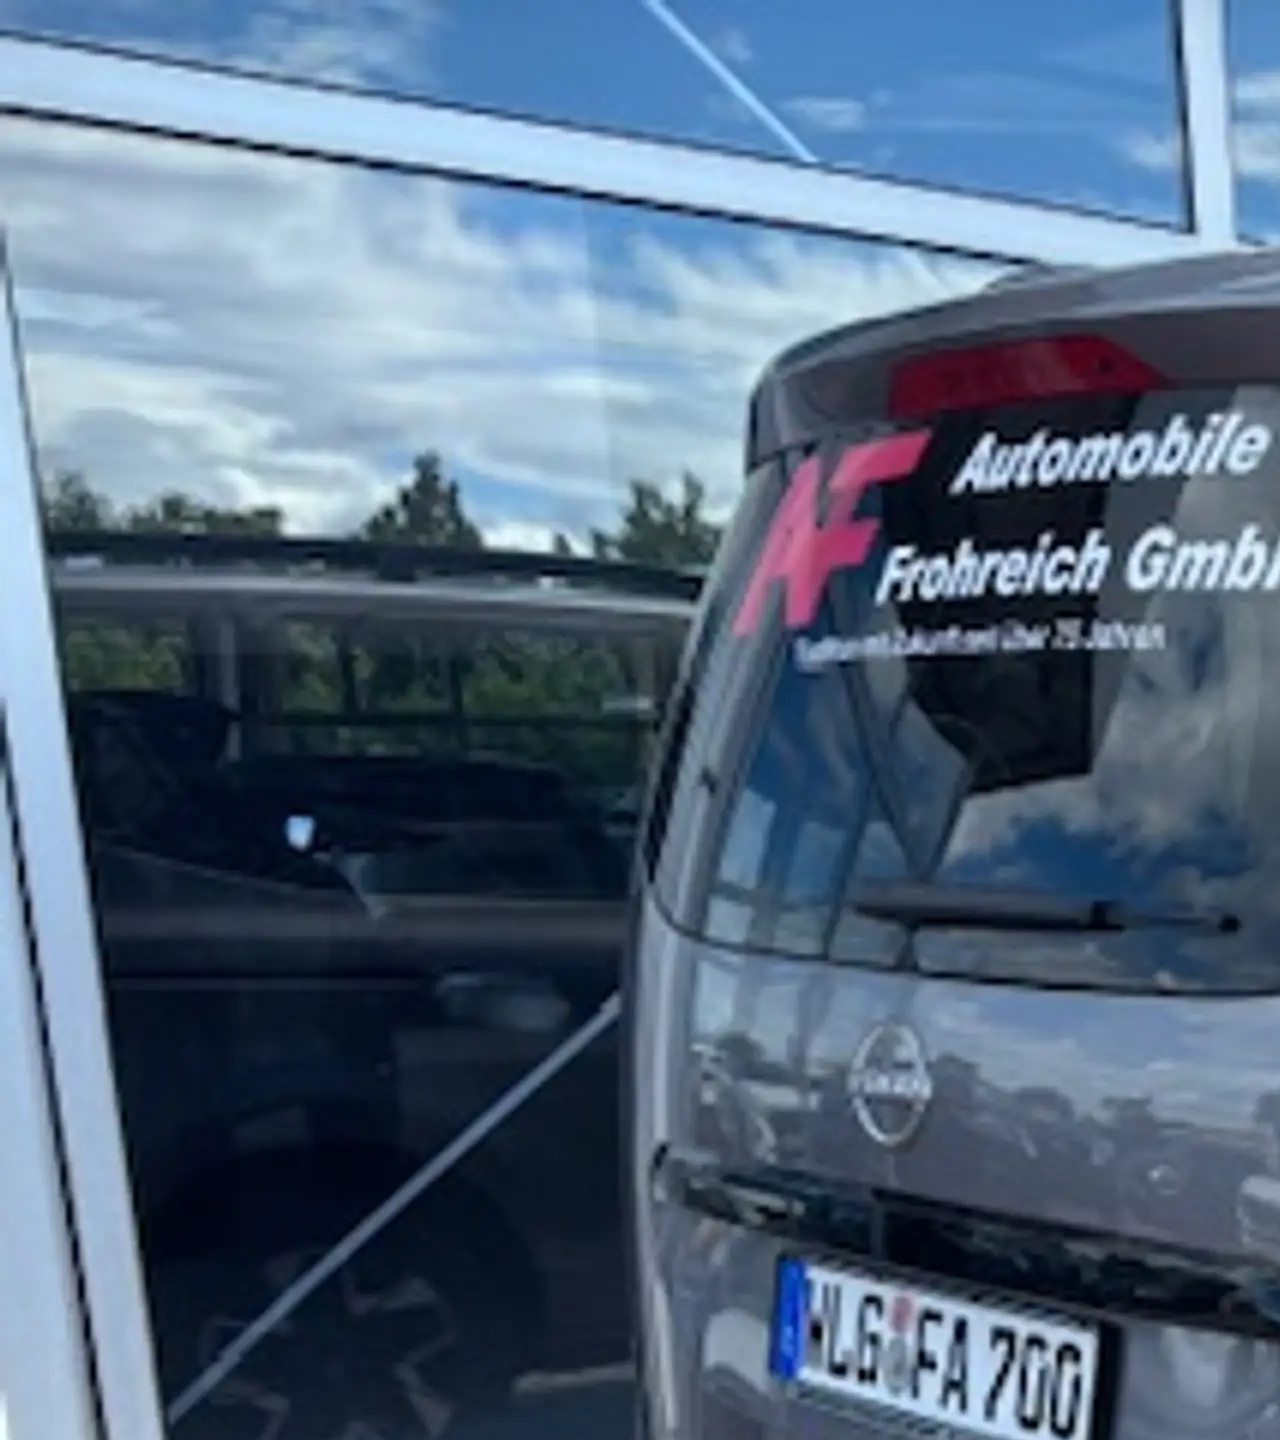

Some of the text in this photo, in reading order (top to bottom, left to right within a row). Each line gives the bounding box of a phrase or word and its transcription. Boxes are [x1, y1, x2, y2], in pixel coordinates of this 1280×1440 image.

[951, 412, 1272, 494] Automobile
[733, 428, 933, 637] AF
[874, 530, 1110, 604] Frohreich
[911, 1307, 968, 1414] FA
[983, 1325, 1083, 1440] 700
